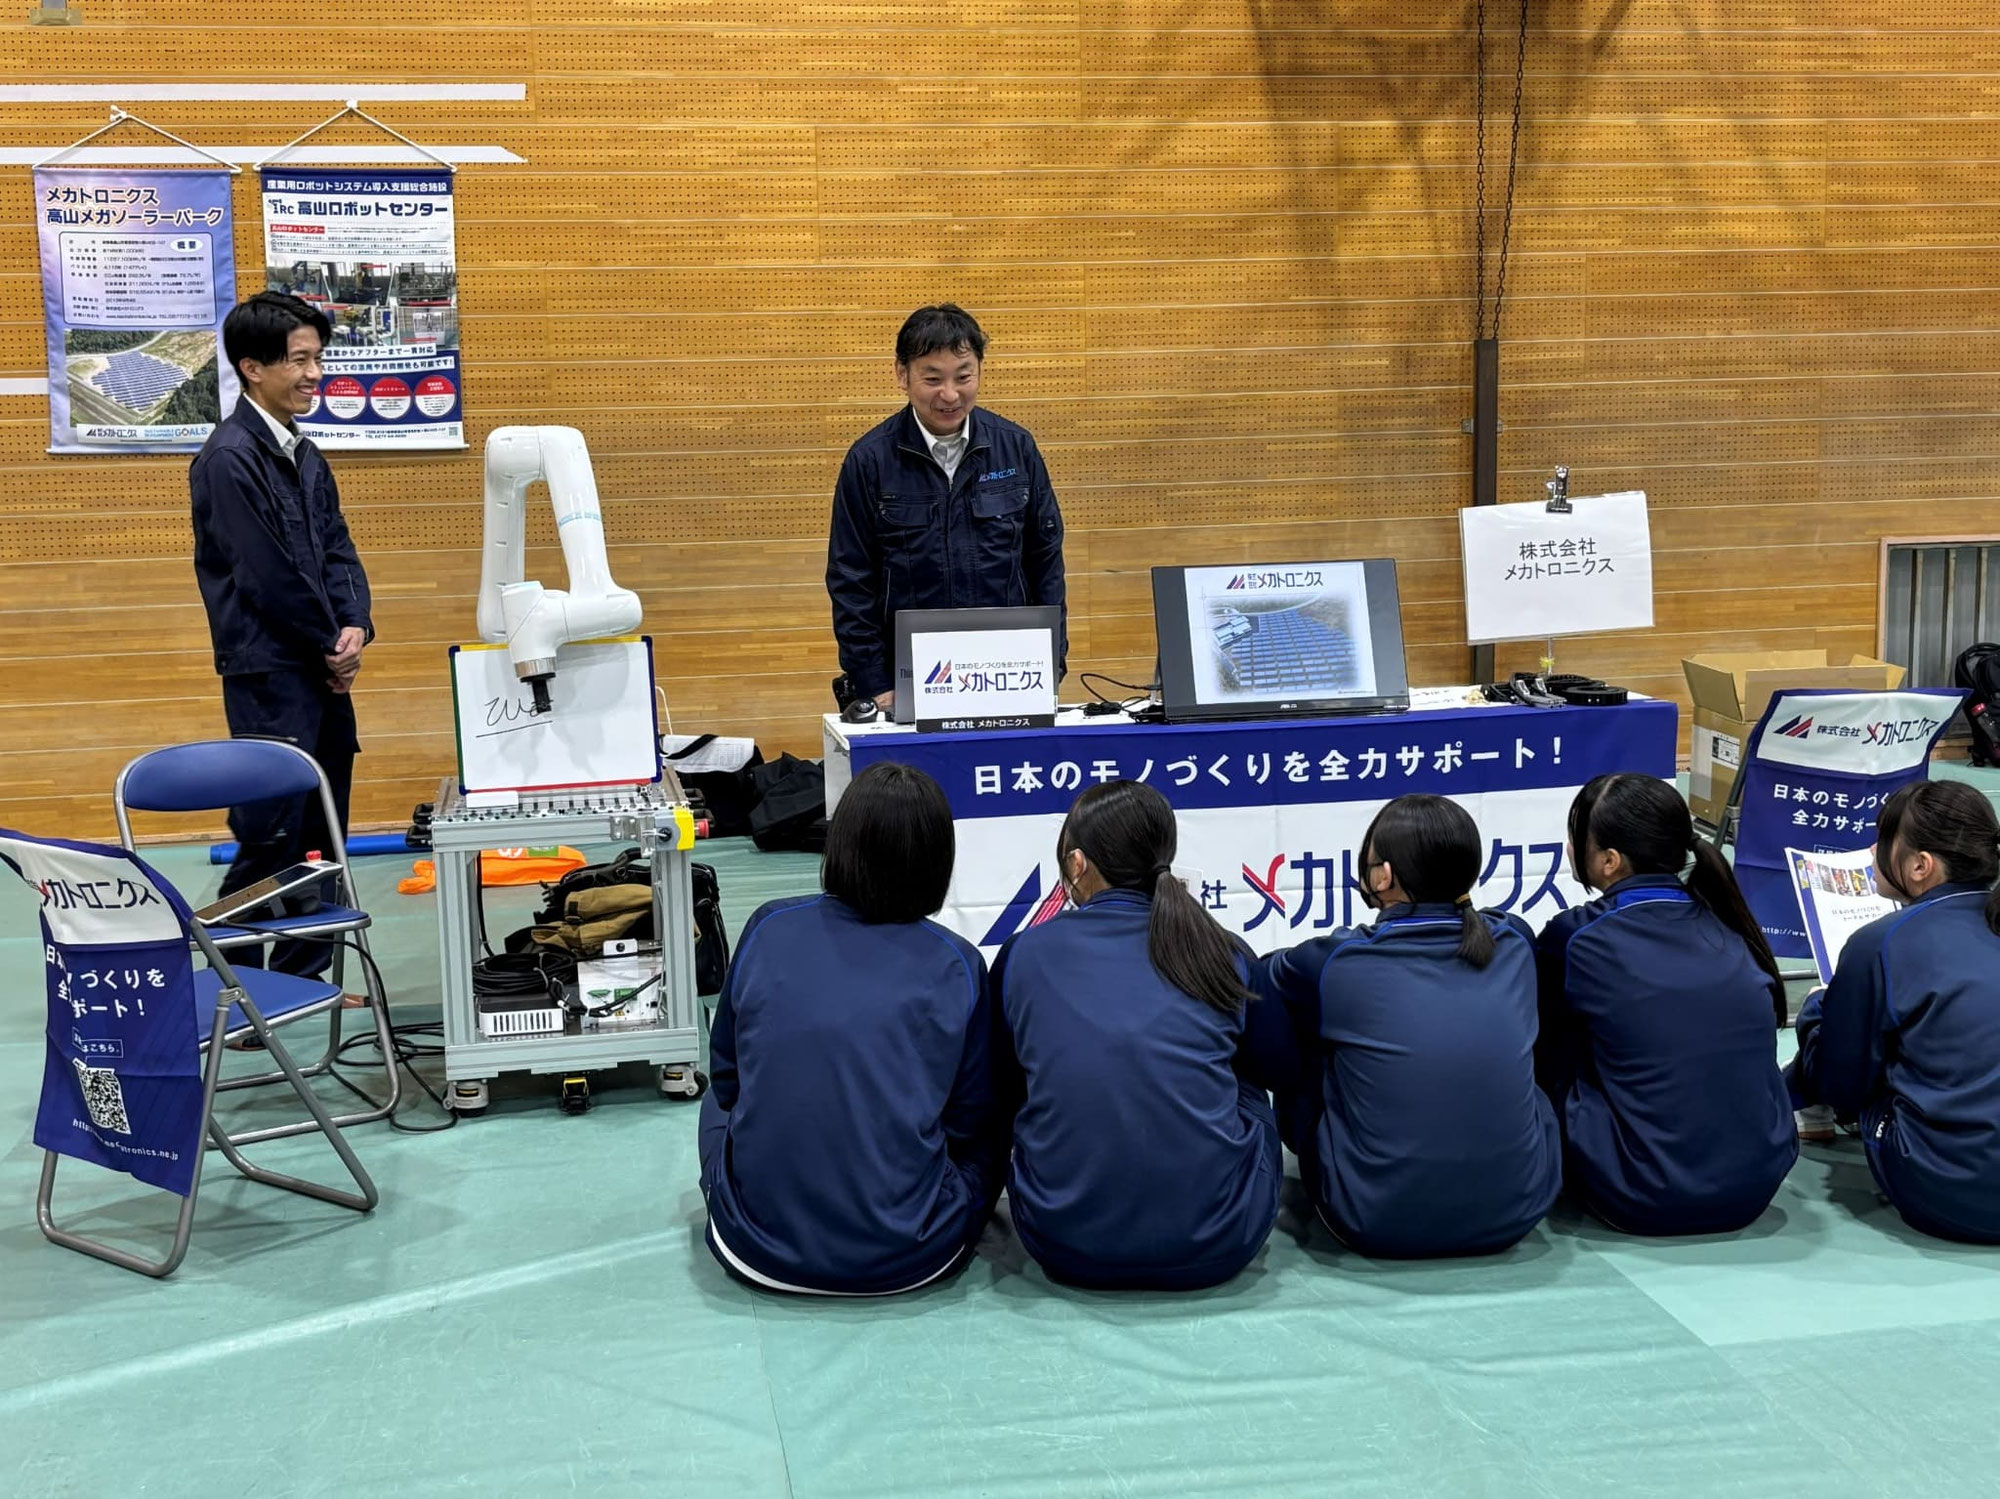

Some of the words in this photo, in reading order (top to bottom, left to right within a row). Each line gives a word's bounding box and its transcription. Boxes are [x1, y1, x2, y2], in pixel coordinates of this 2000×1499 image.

[47, 187, 158, 205] メカトロニクス
[47, 207, 223, 225] 高山メガソーラーパーク
[297, 200, 448, 217] 高山ロボットセンター
[174, 426, 208, 437] GOALS
[303, 430, 361, 438] 山ロボットセンター
[1519, 537, 1597, 560] 株式会社
[1504, 558, 1615, 581] メカトロニクス
[1257, 571, 1324, 589] メカトロニクス
[924, 686, 954, 695] 株式会社
[958, 671, 1044, 692] メカトロニクス
[941, 719, 975, 730] 株式会社
[977, 717, 1031, 728] メカトロニクス
[1816, 724, 1861, 738] 株式会社
[1773, 783, 1889, 810] 日本のモノづく
[1791, 809, 1878, 834] 全力サポー
[37, 878, 160, 909] メカトロニクス
[1242, 838, 1568, 932] メカトクス
